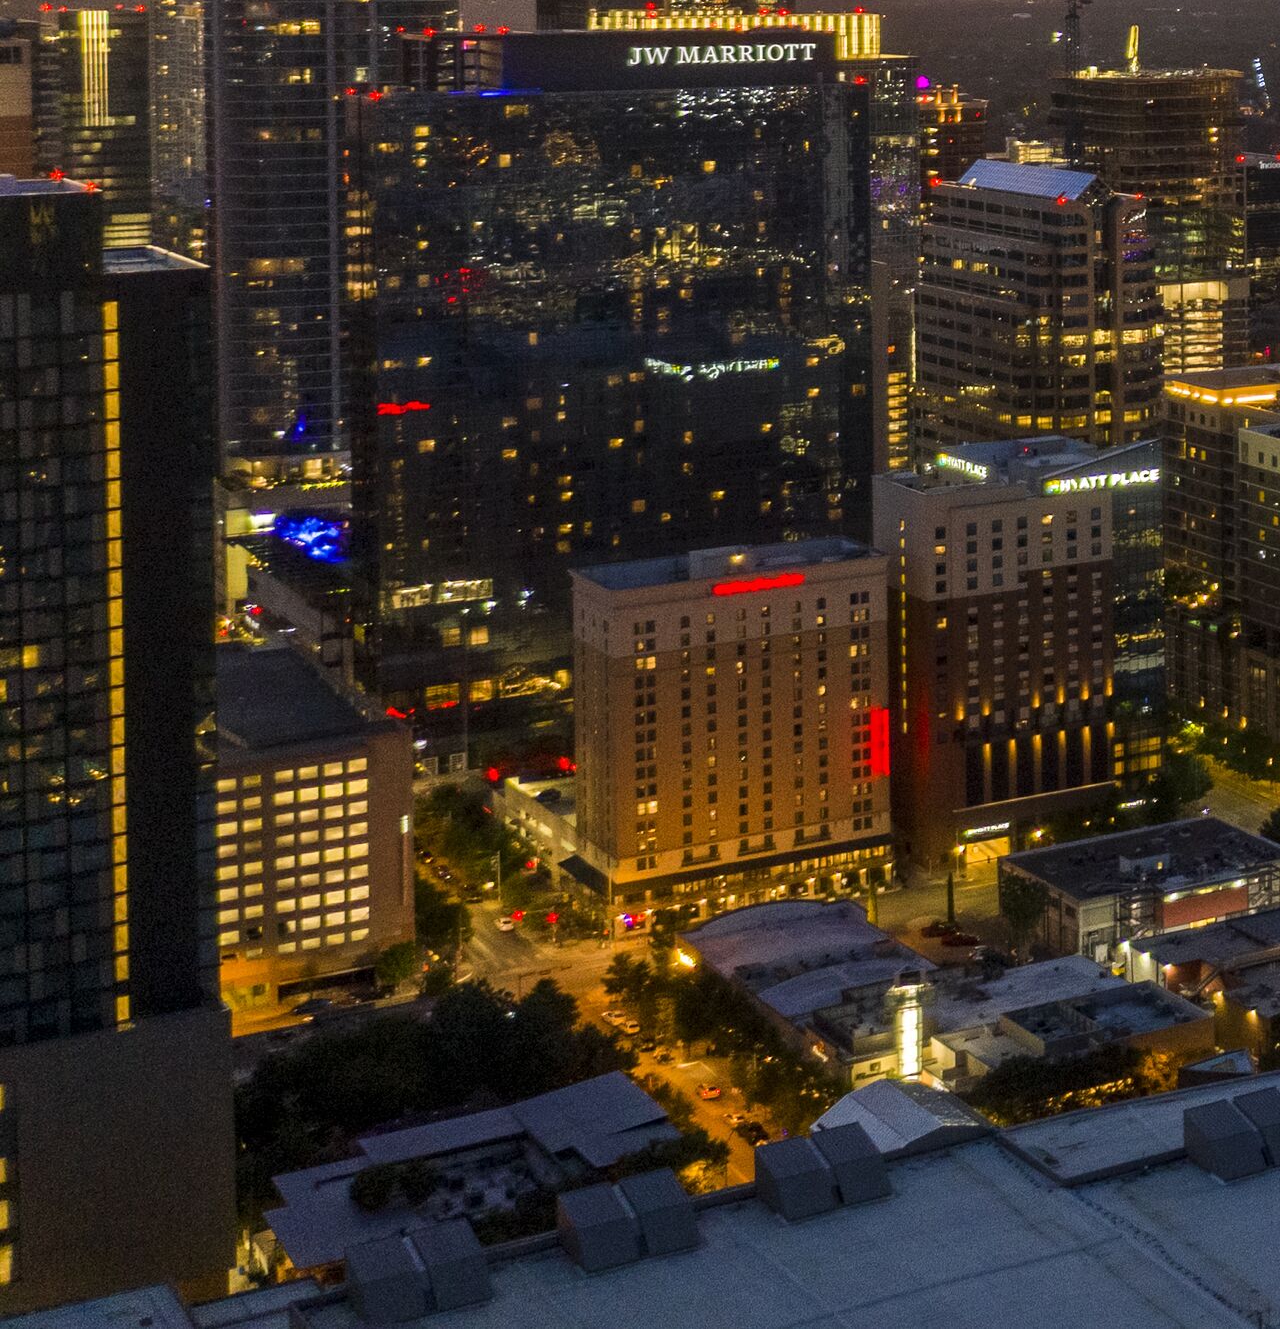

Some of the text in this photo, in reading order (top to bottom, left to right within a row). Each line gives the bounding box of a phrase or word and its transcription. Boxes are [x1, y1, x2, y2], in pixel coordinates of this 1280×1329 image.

[629, 43, 816, 65] JW MARRIOTT
[1060, 469, 1160, 492] HYATT PLACE
